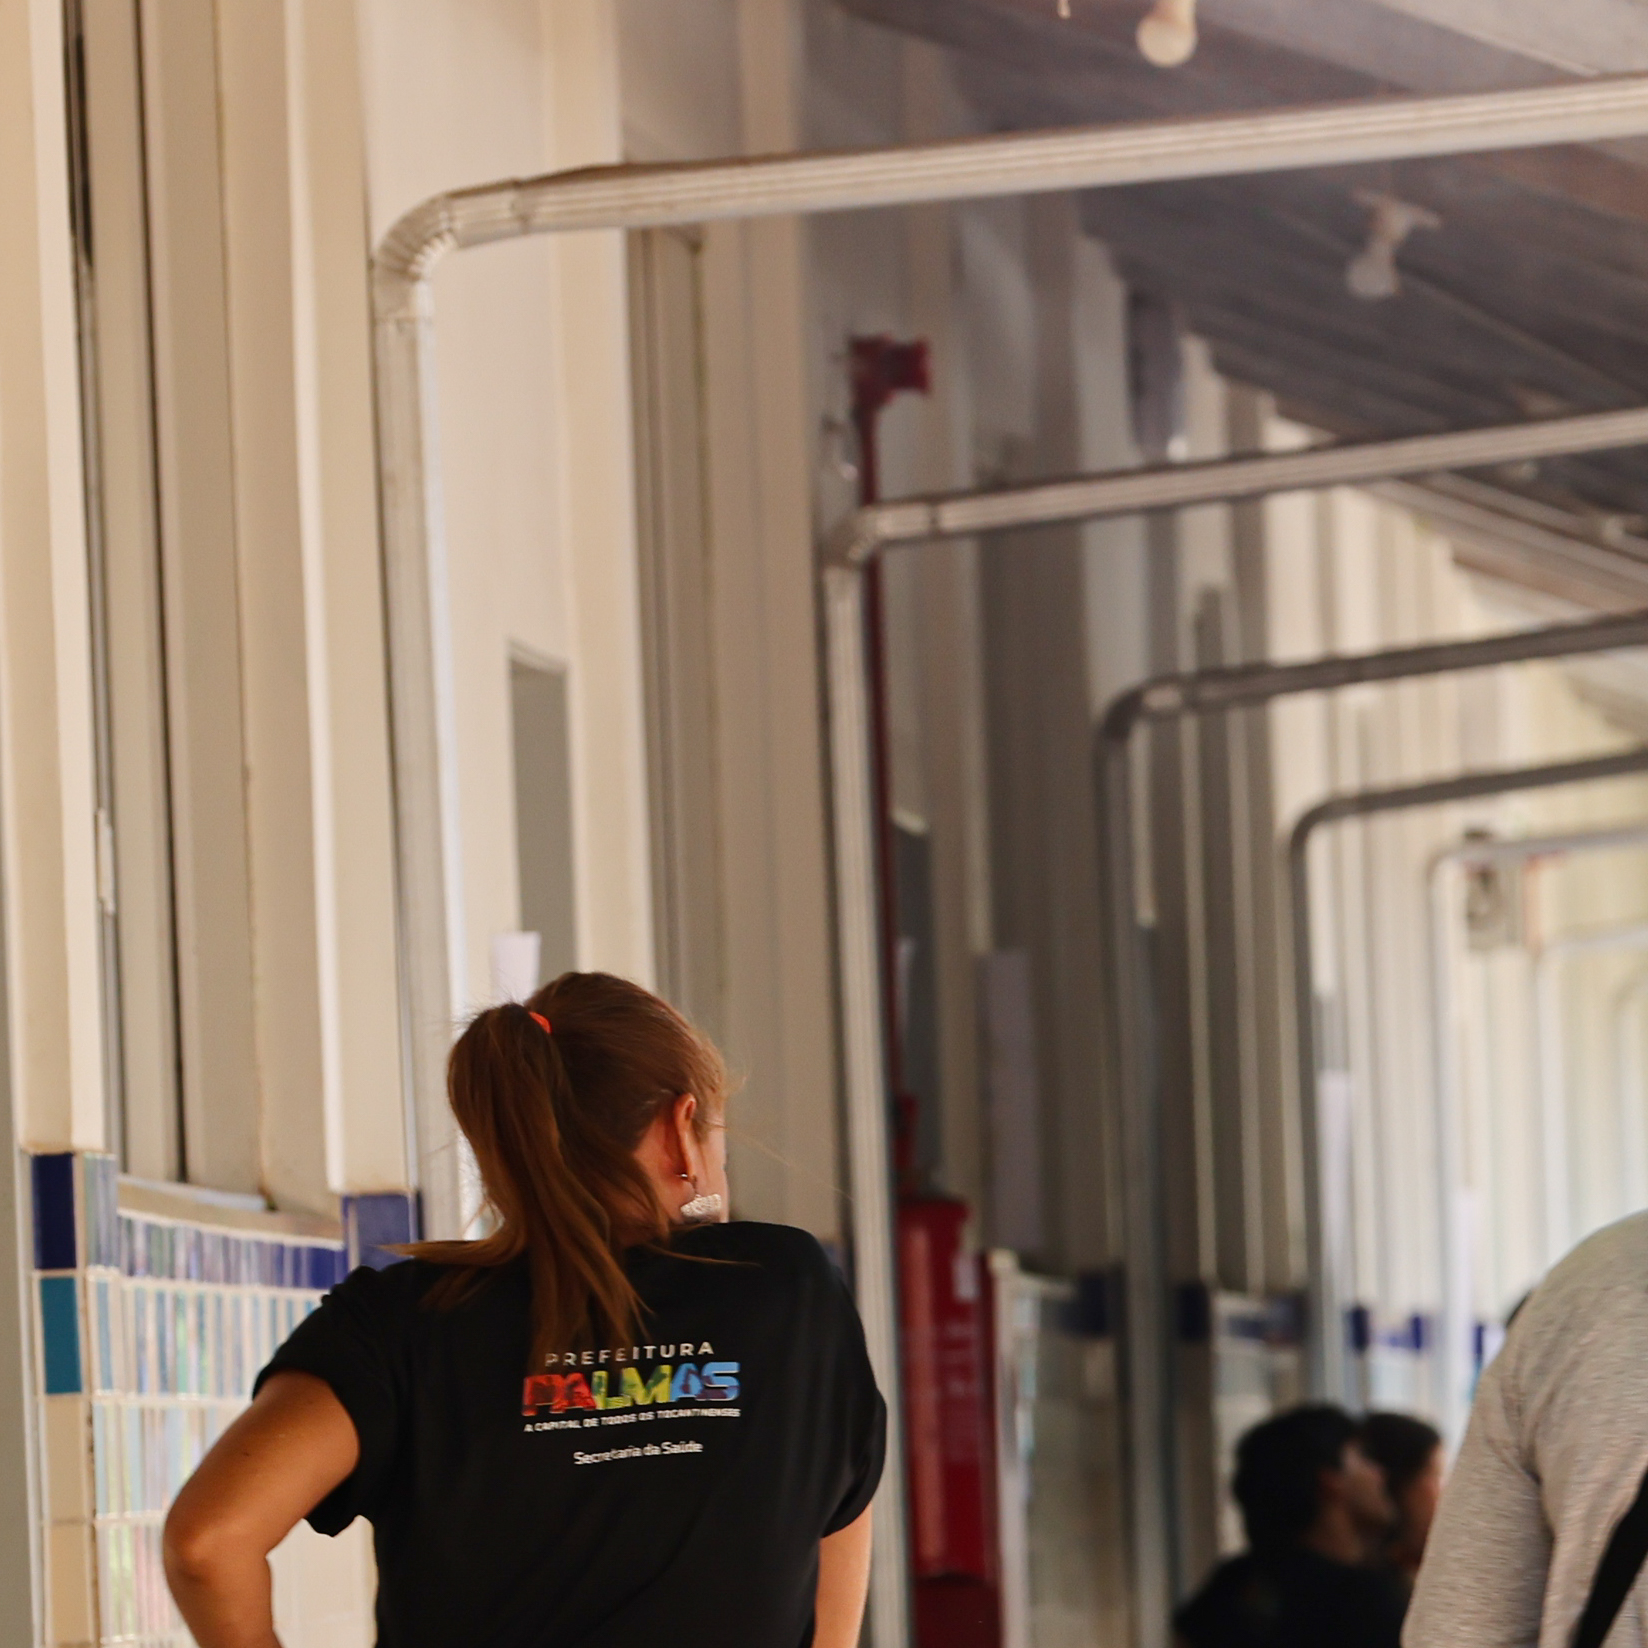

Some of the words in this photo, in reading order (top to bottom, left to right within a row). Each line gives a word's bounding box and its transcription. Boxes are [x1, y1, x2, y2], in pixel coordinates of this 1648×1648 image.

[545, 1341, 714, 1367] PREFEITURA
[521, 1361, 740, 1417] PALMAS
[523, 1423, 533, 1433] A
[535, 1419, 582, 1432] CAPITAL
[583, 1417, 599, 1428] DE
[601, 1413, 637, 1426] TODOS
[573, 1444, 642, 1465] Secretaria
[643, 1443, 661, 1456] da
[661, 1440, 703, 1455] Saúde
